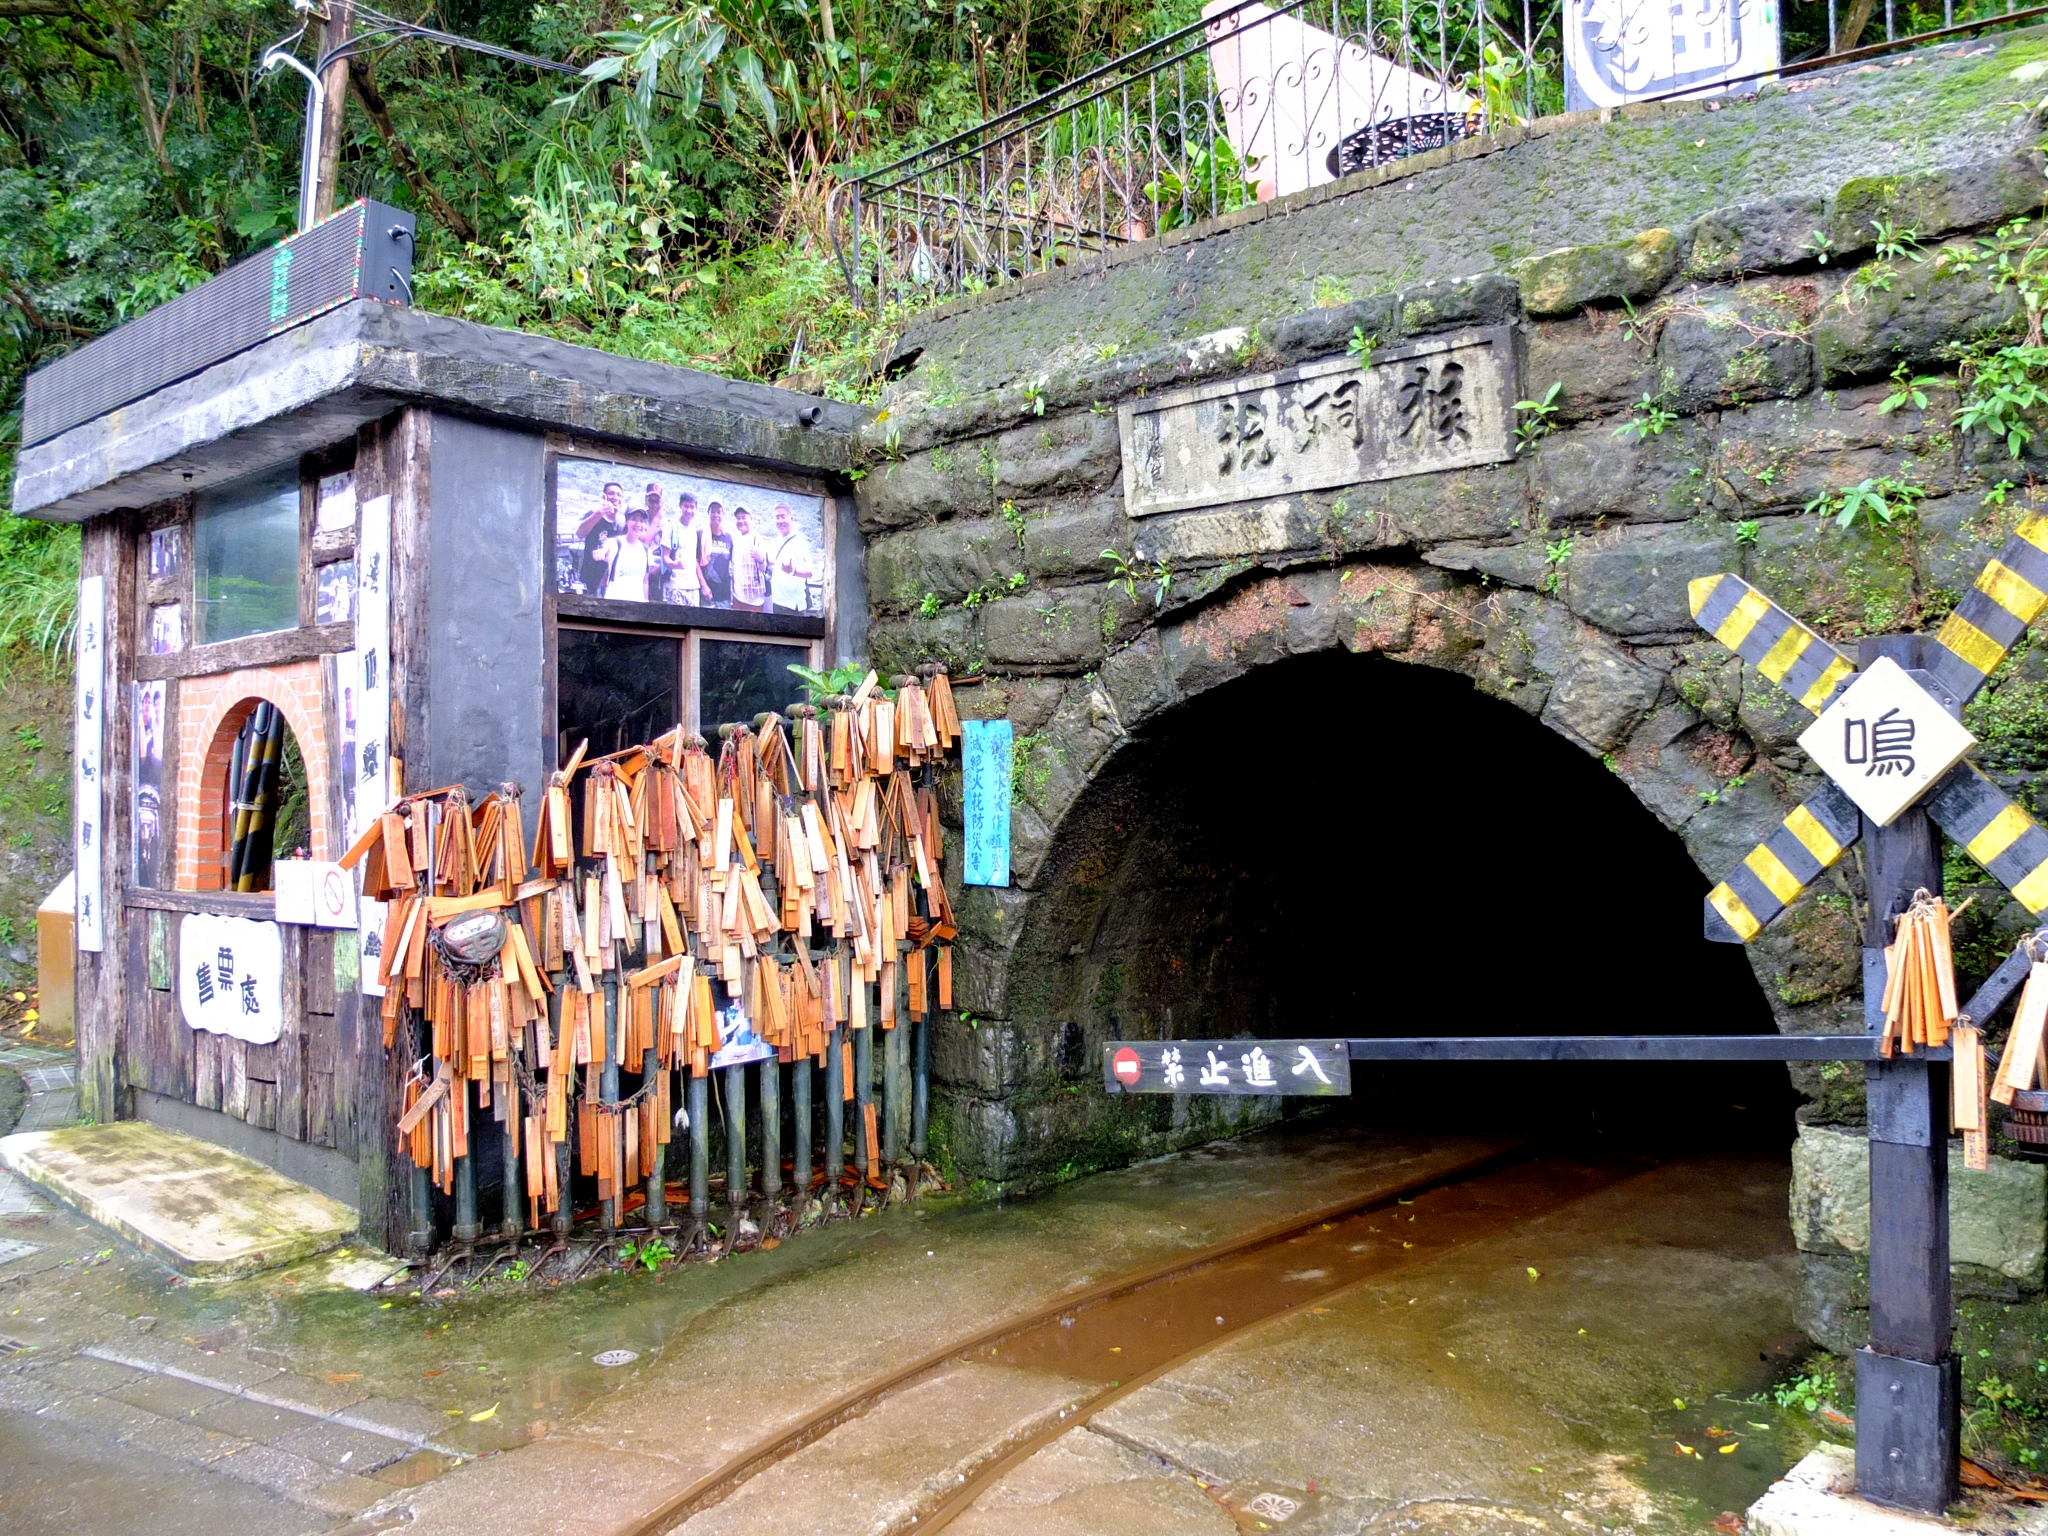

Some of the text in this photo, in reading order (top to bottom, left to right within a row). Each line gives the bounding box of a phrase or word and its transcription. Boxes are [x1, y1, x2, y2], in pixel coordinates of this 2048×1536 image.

[1844, 707, 1916, 778] 鳴
[195, 946, 261, 1016] 售票處
[1160, 1045, 1332, 1089] 禁止進入
